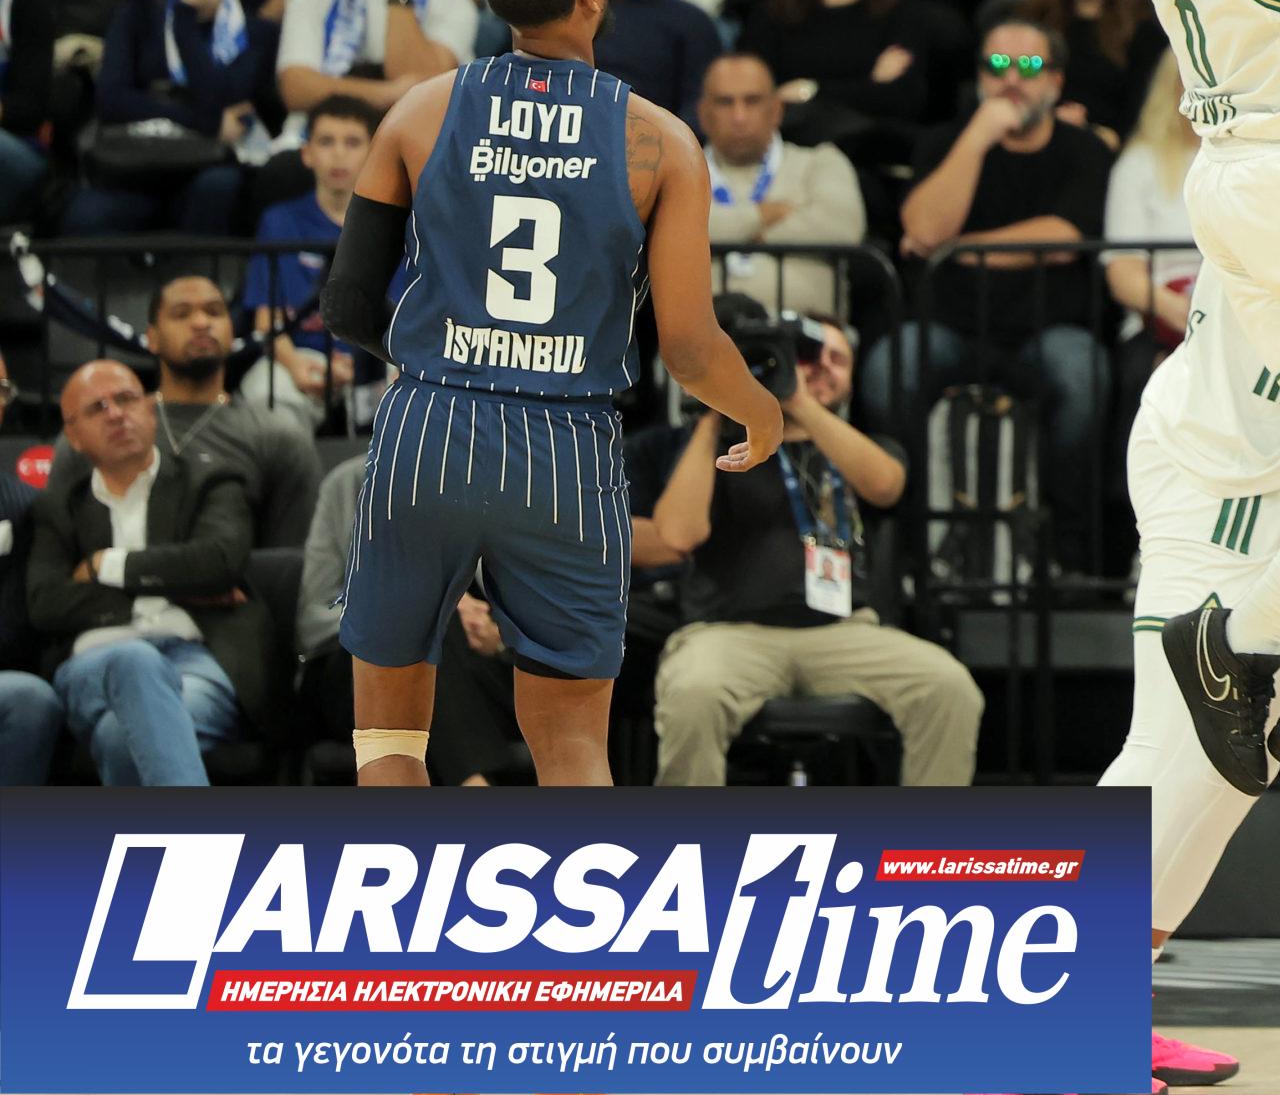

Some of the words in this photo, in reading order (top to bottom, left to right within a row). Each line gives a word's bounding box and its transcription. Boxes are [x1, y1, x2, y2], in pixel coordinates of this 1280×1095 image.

[488, 95, 583, 144] LOYD
[469, 138, 598, 184] Bilyoner
[485, 194, 562, 325] 3
